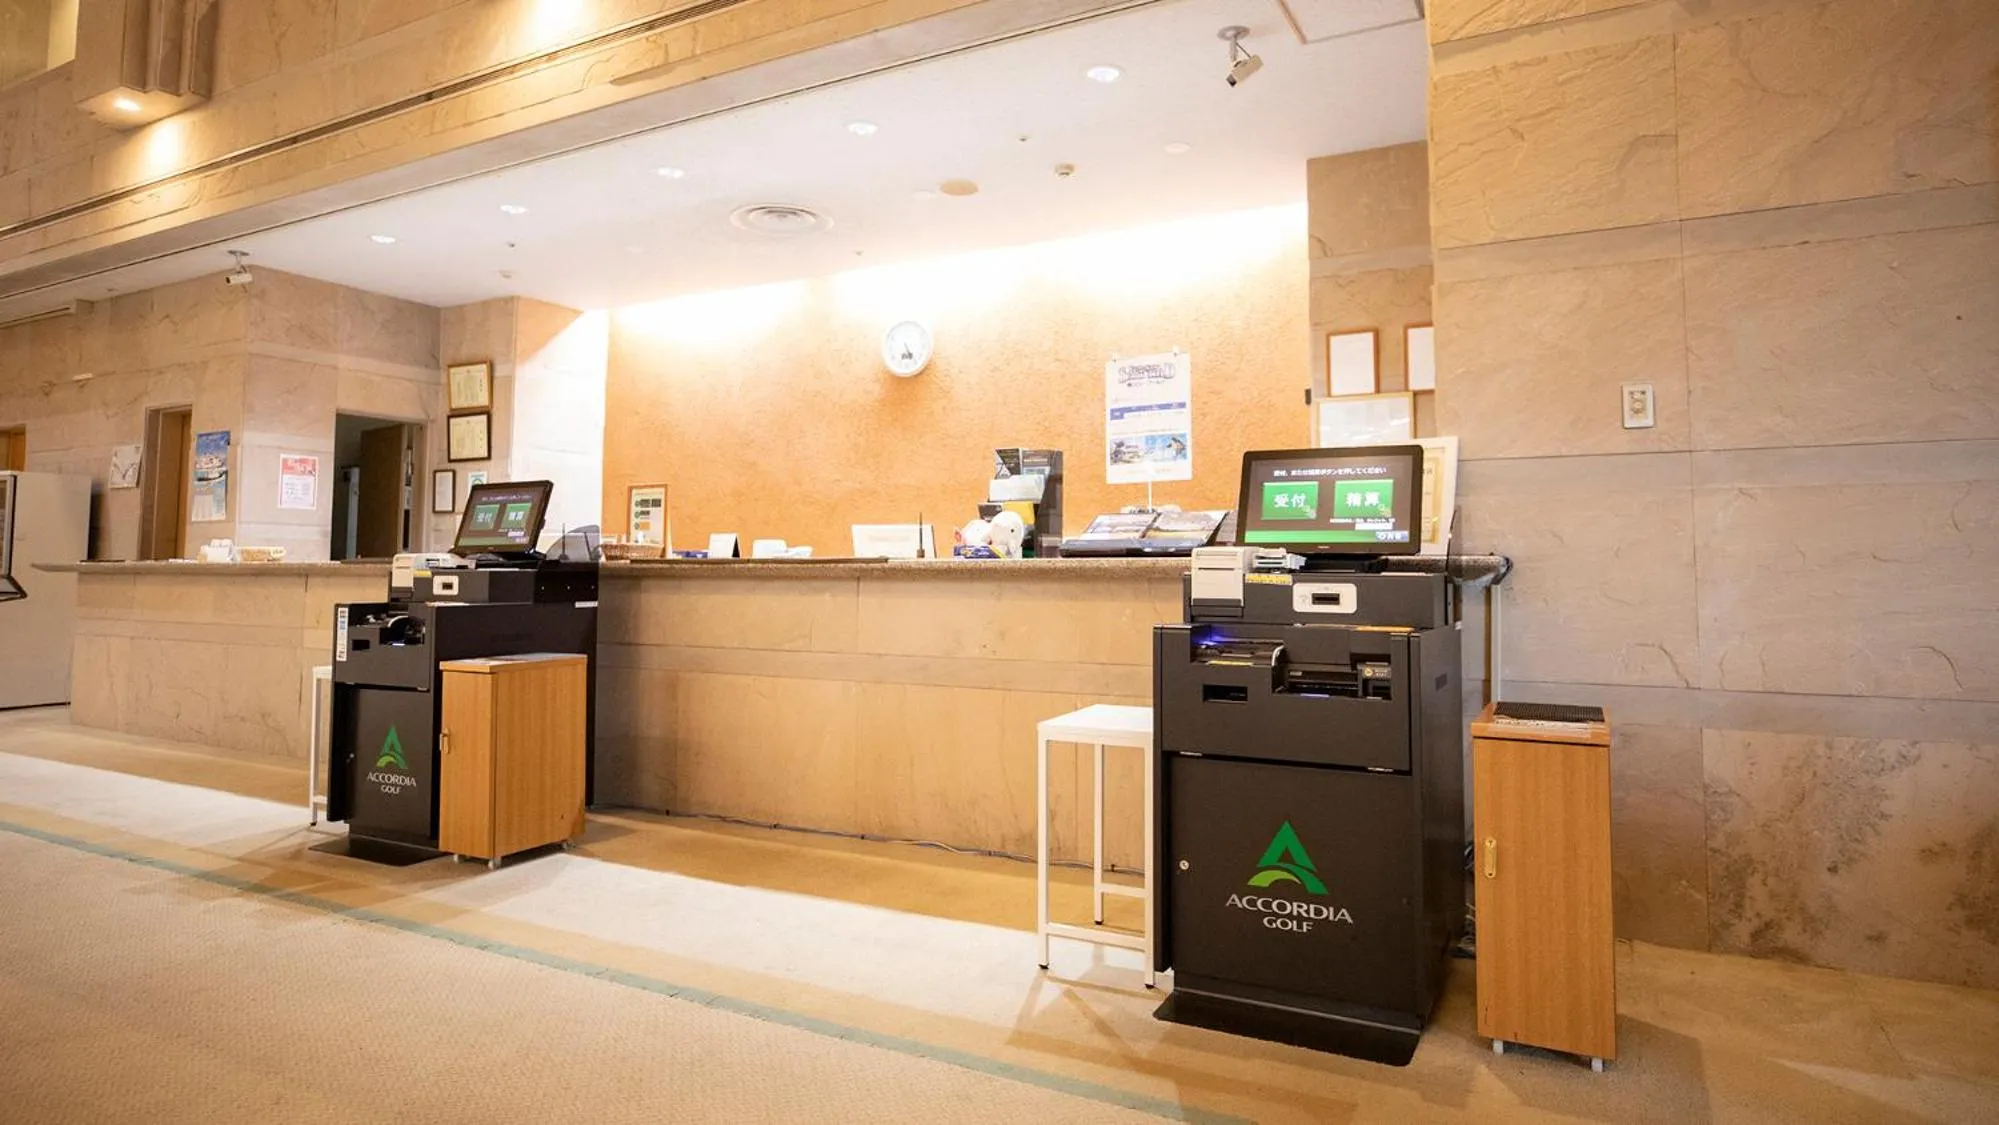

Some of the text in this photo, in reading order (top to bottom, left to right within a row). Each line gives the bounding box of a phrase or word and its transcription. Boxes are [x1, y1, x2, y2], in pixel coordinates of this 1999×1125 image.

[1273, 493, 1307, 508] 受付
[366, 772, 416, 787] ACCORDIA
[381, 785, 401, 795] GOLF
[1225, 893, 1353, 924] ACCORDIA
[1263, 916, 1313, 933] GOLF
